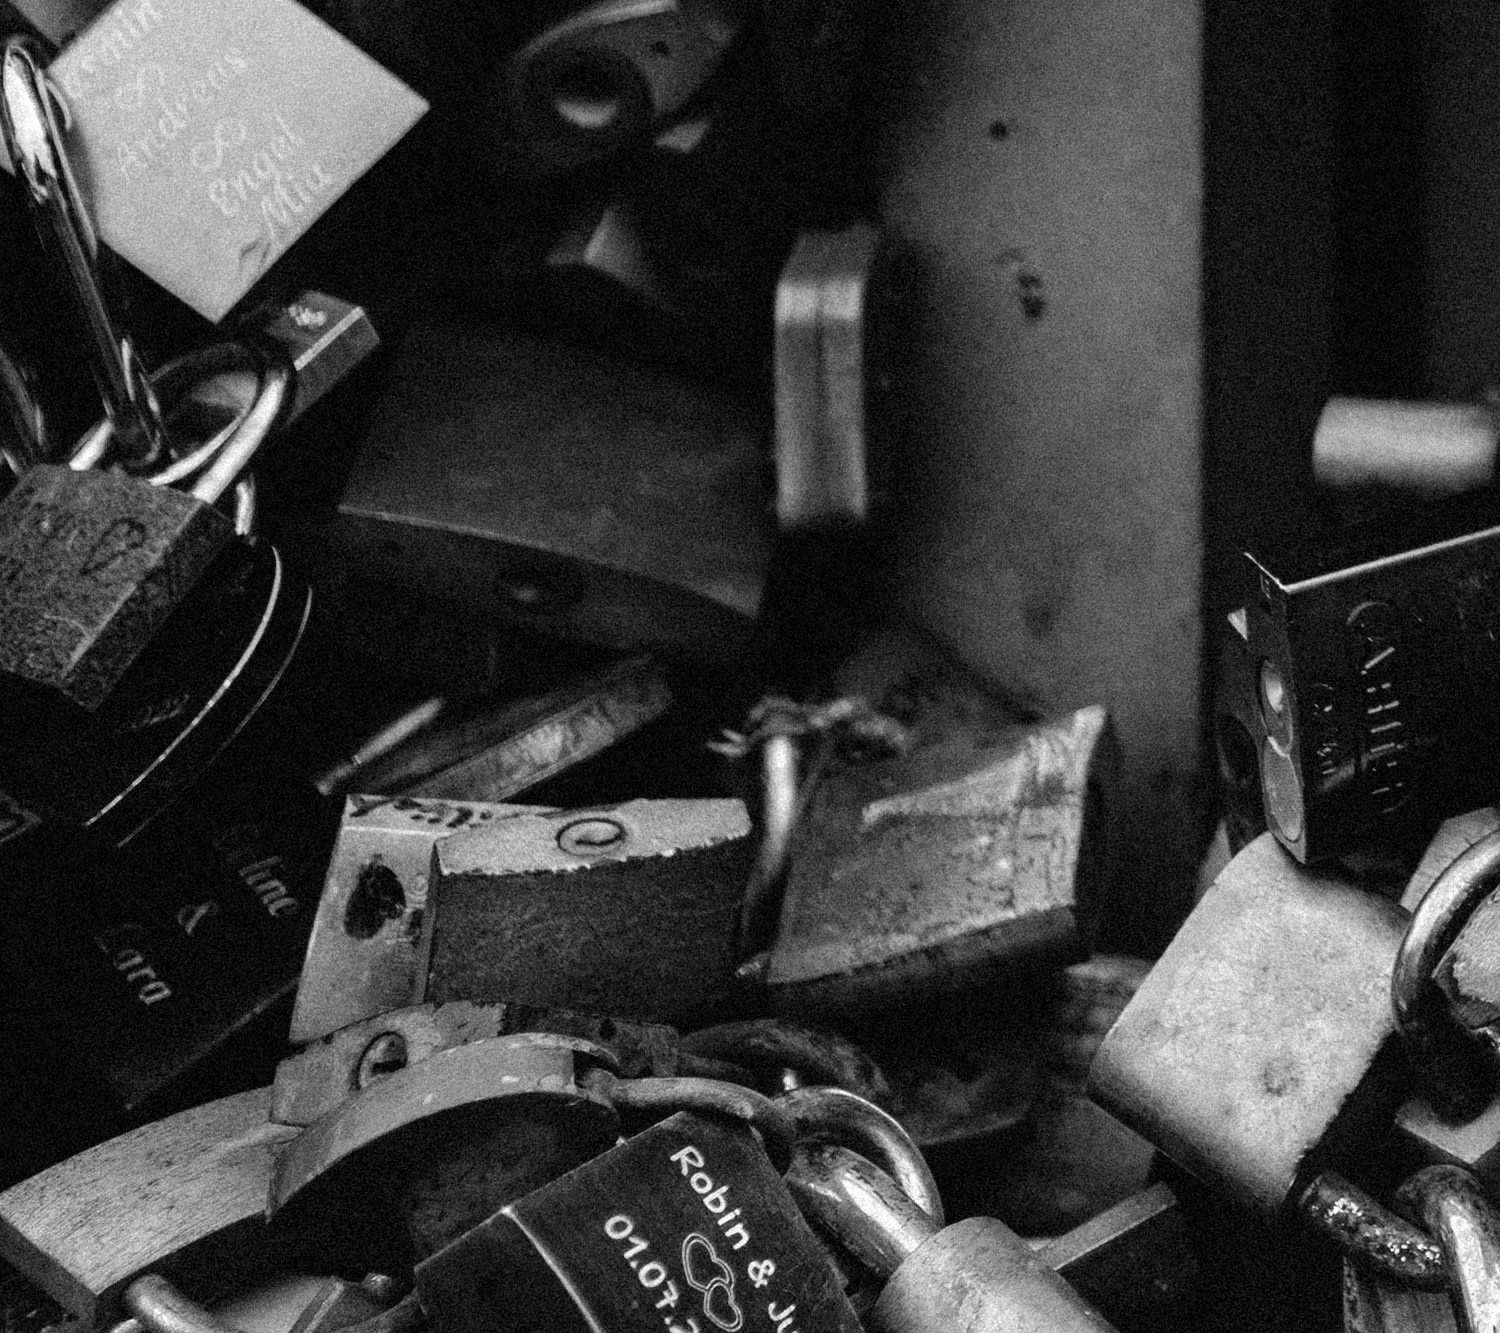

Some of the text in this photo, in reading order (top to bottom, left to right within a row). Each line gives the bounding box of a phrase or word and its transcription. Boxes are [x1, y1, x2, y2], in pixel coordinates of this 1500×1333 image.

[121, 47, 247, 175] Andreas
[207, 116, 303, 217] Engel
[670, 1145, 750, 1251] Robin
[747, 1258, 776, 1289] &
